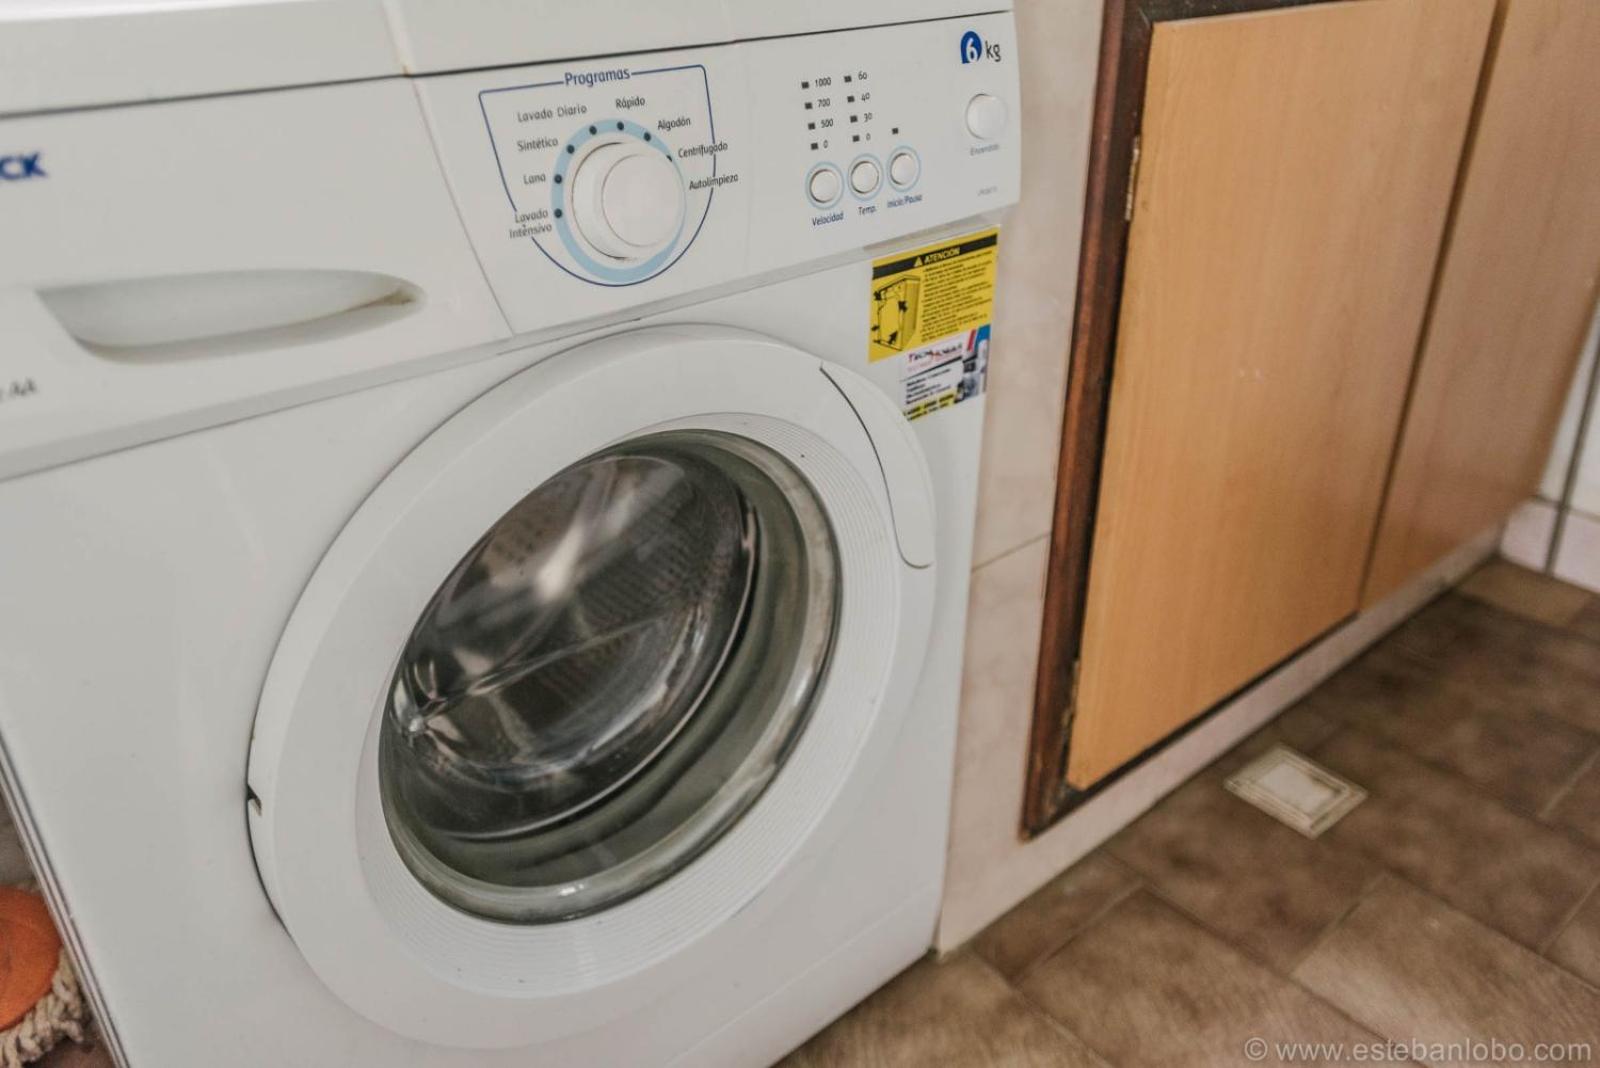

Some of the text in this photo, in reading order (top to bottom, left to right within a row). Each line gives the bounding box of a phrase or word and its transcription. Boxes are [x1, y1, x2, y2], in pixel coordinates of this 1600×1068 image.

[985, 41, 1001, 62] kg
[564, 68, 631, 88] Programas
[815, 77, 831, 87] 1000
[858, 71, 867, 80] 60
[615, 96, 645, 109] Rápido
[818, 98, 831, 108] 700
[861, 92, 870, 102] 40
[517, 104, 587, 122] Lavado Diario
[864, 112, 873, 122] 30
[657, 117, 691, 131] Algodón
[821, 118, 834, 128] 500
[517, 136, 559, 151] Sintético
[678, 142, 728, 158] Centrifugado
[524, 173, 546, 185] Lana
[689, 173, 738, 190] Autolimpieza
[515, 208, 548, 223] Lavado
[812, 211, 844, 226] Velocidad
[509, 222, 552, 239] Intensivo
